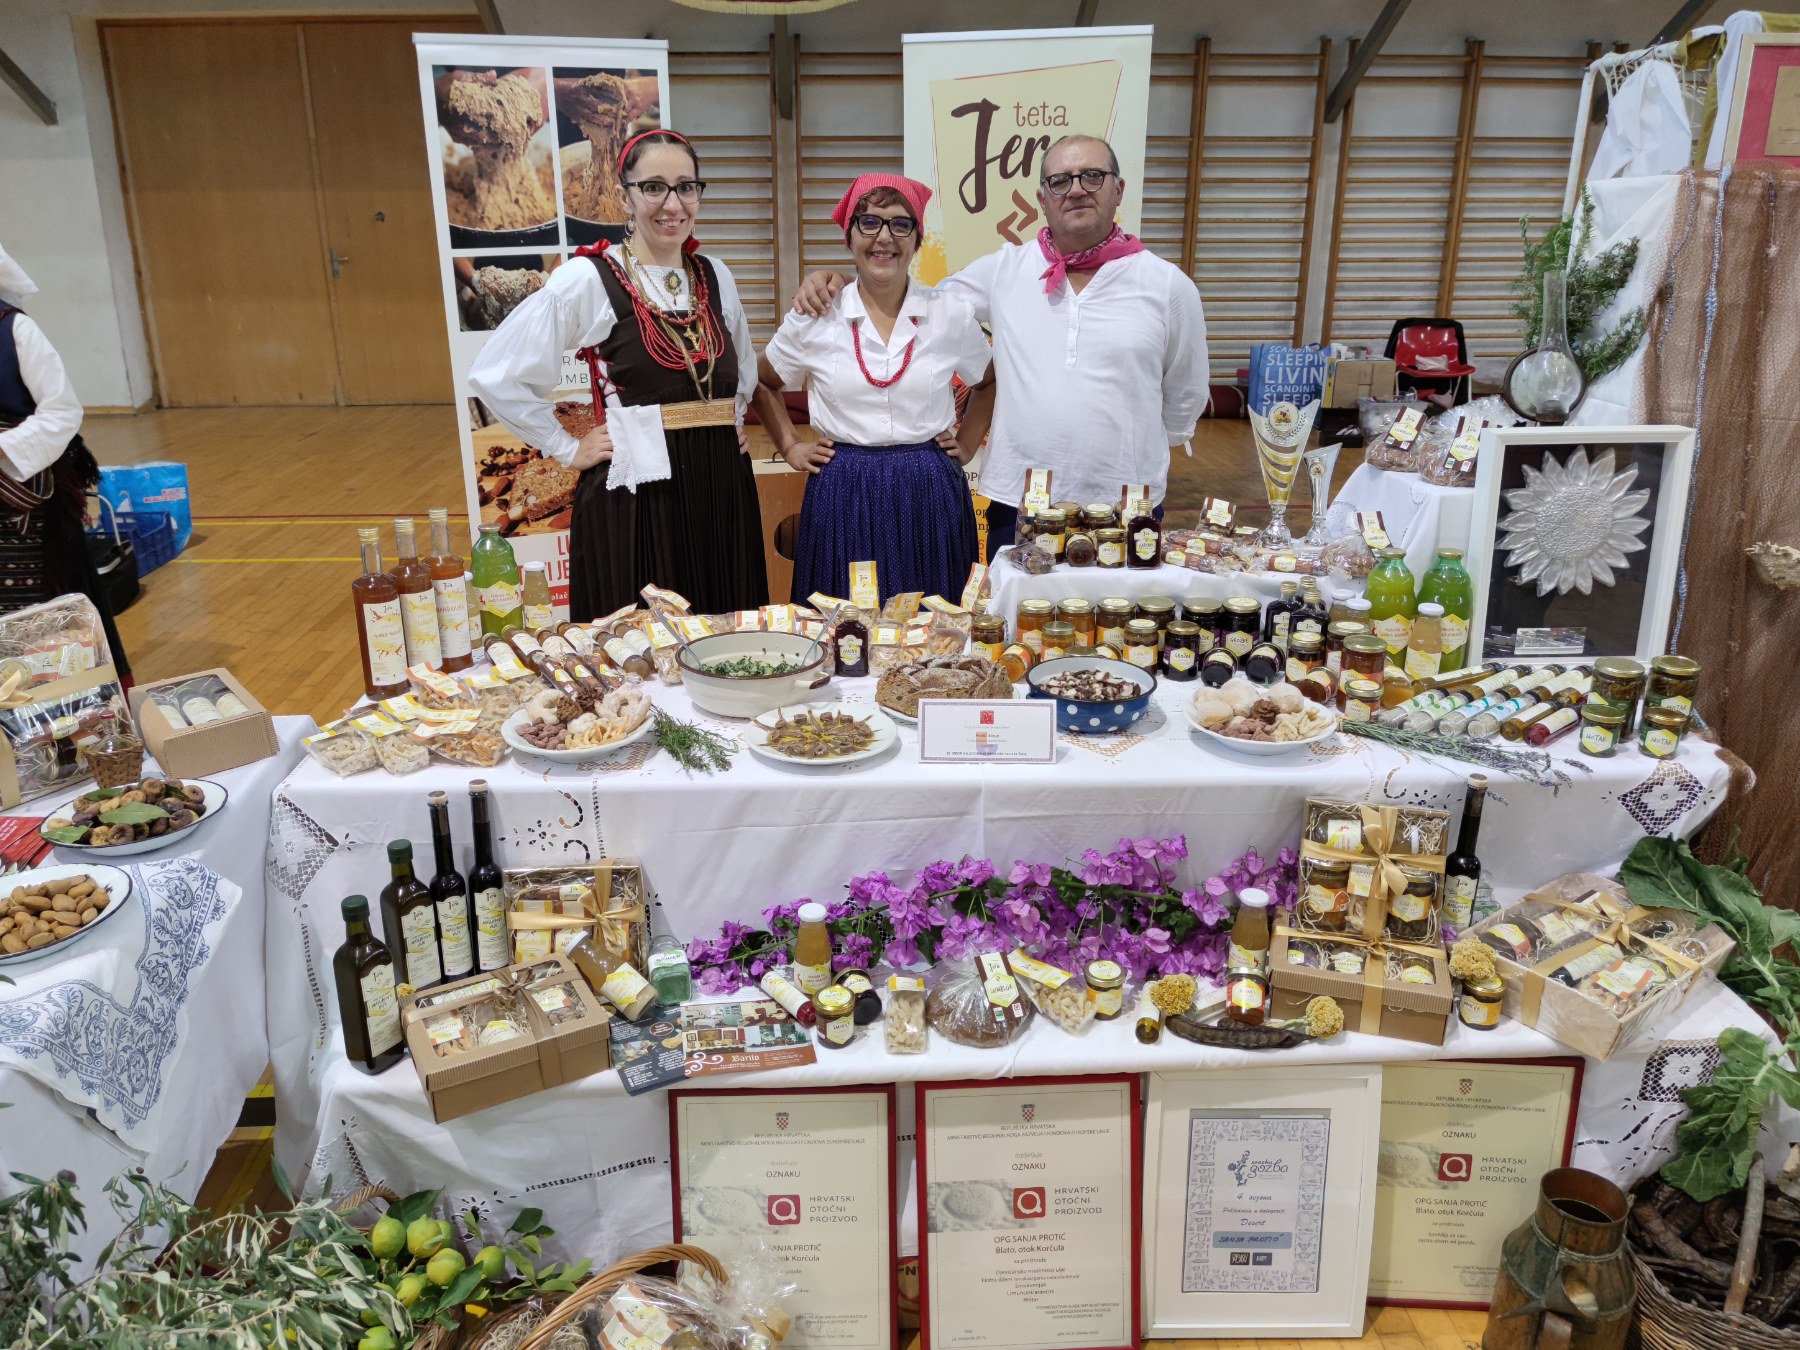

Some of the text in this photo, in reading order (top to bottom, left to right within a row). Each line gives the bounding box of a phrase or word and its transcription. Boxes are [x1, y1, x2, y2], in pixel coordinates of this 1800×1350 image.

[1013, 101, 1069, 128] teta
[951, 98, 1065, 214] Jer
[1442, 1130, 1477, 1139] OZNAKU
[1481, 1156, 1527, 1165] HRVATSKI
[1011, 1163, 1046, 1171] OZNAKU
[1480, 1165, 1517, 1174] OTOČNI
[766, 1170, 801, 1179] OZNAKU
[1479, 1175, 1527, 1184] PROIZVOD
[1054, 1186, 1100, 1195] HRVATSKI
[809, 1195, 856, 1203] HRVATSKI
[1054, 1196, 1091, 1205] OTOČNI
[1414, 1197, 1488, 1208] OPG SANJA PROTIĆ
[809, 1205, 847, 1213] OTOČNI
[1054, 1207, 1103, 1215] PROIZVOD
[809, 1215, 859, 1223] PROIZVOD
[1240, 1218, 1266, 1227] Desert
[993, 1233, 1067, 1244] OPG SANJA PROTIĆ
[793, 1243, 822, 1252] PROTIĆ
[995, 1244, 1065, 1255] Blato, otok Korčula
